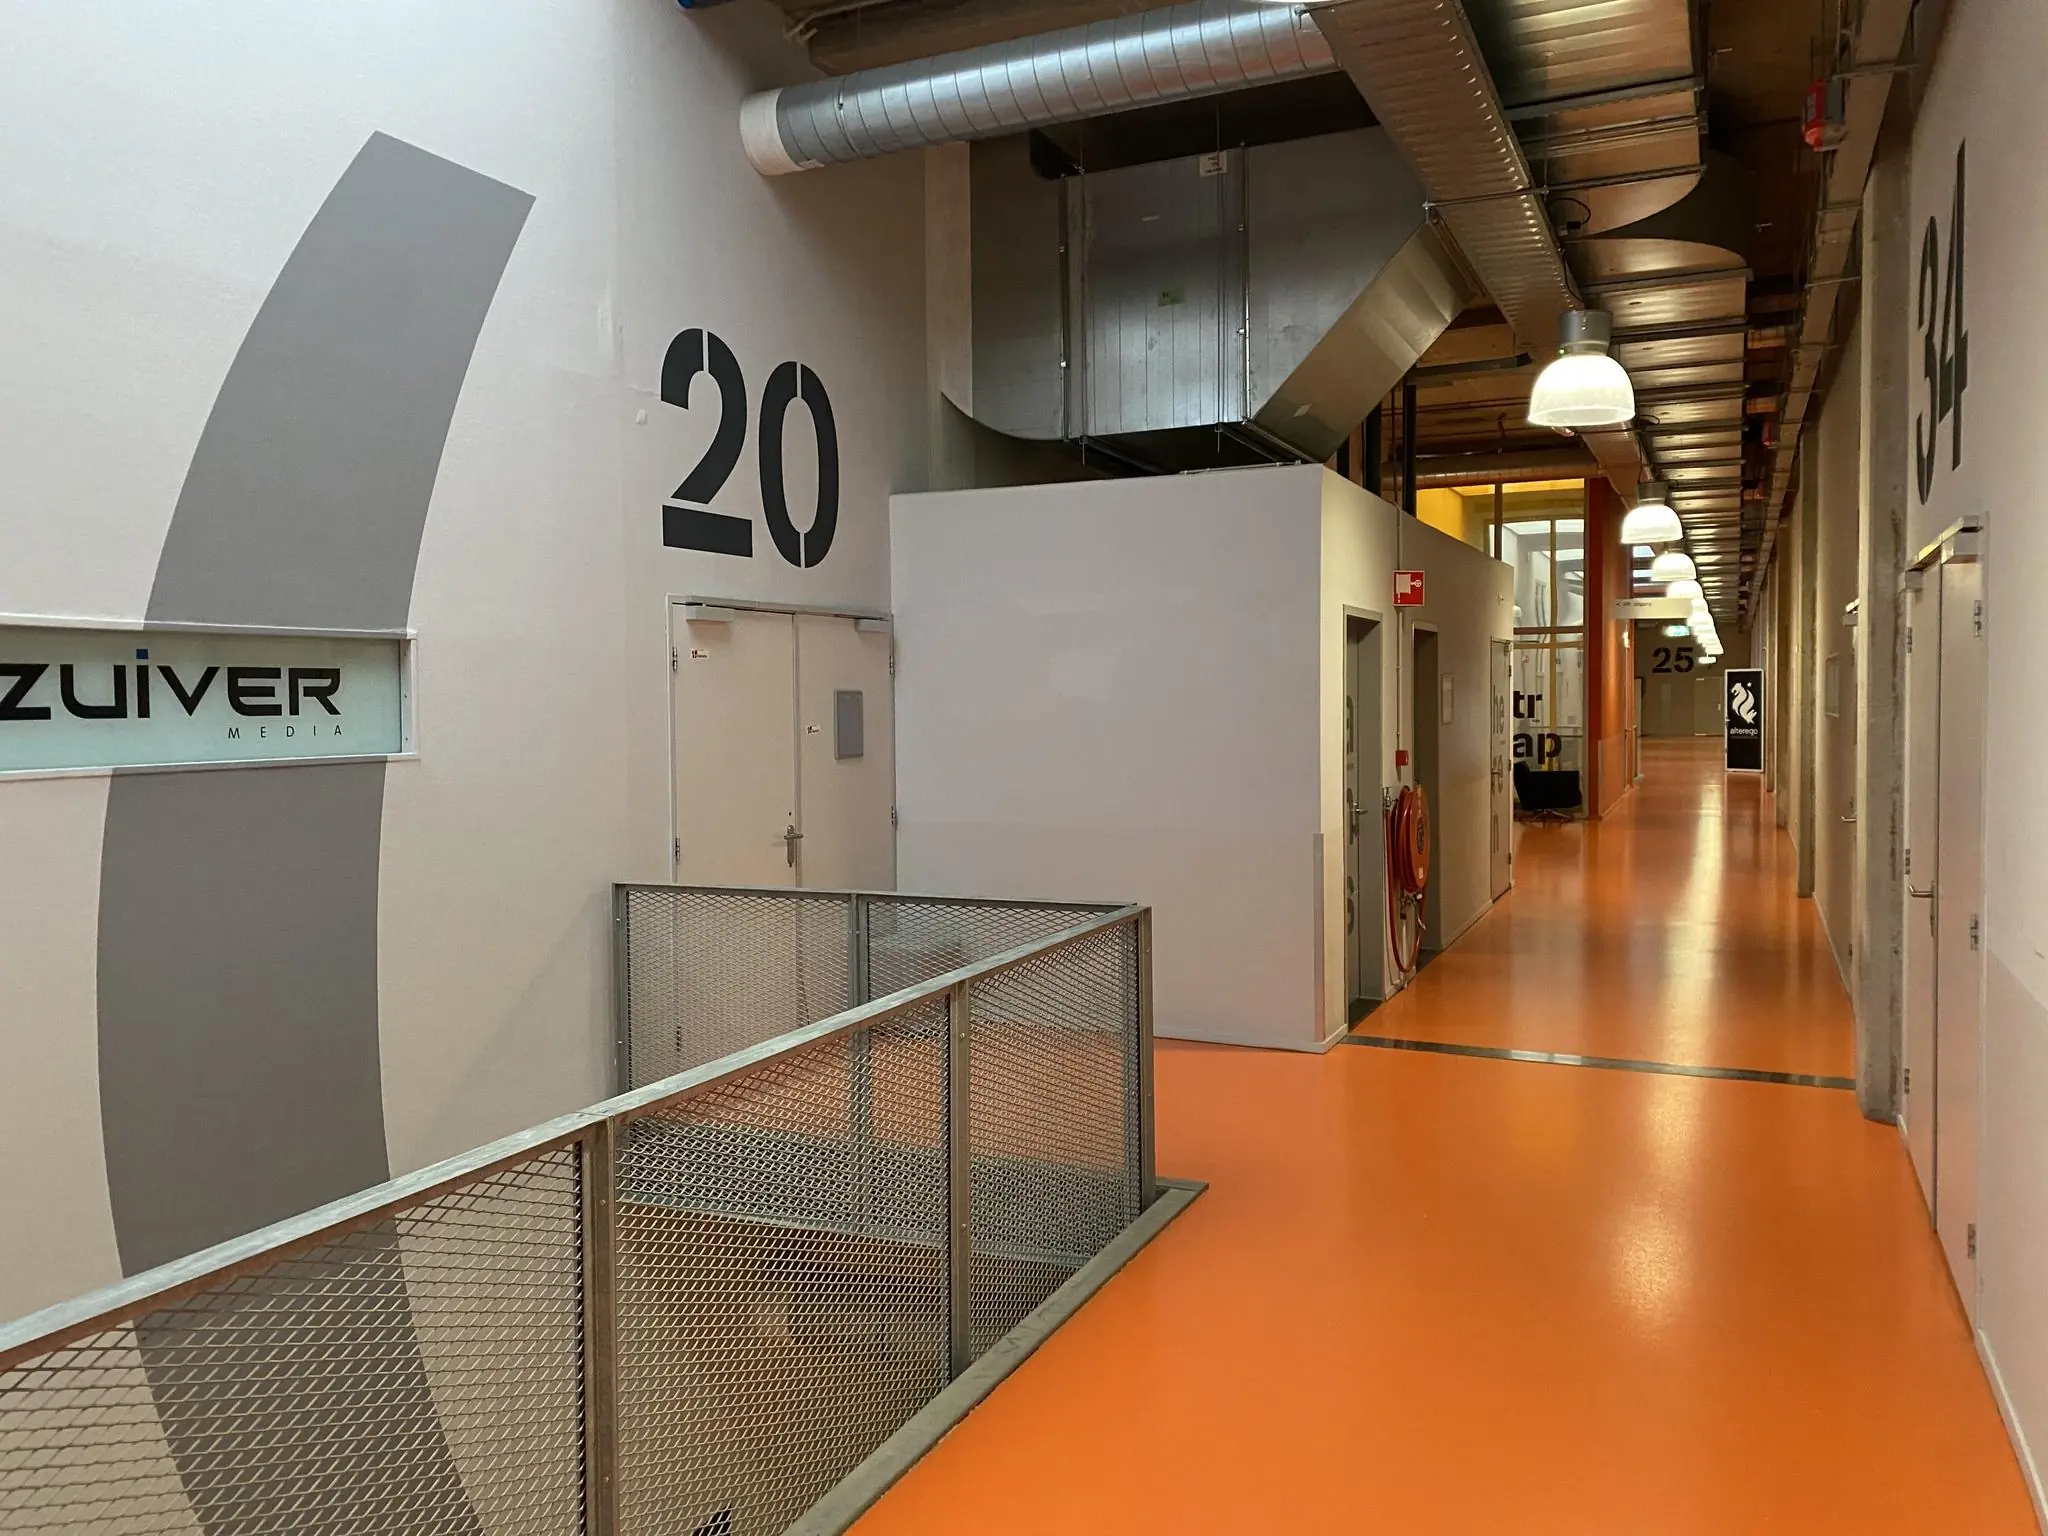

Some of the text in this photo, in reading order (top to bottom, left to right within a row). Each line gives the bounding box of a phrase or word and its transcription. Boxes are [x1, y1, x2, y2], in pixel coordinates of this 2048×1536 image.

[1916, 138, 1969, 506] 34
[660, 327, 840, 569] 20
[1652, 646, 1695, 675] 25
[227, 724, 343, 740] MEDIA
[1729, 726, 1759, 737] alterego
